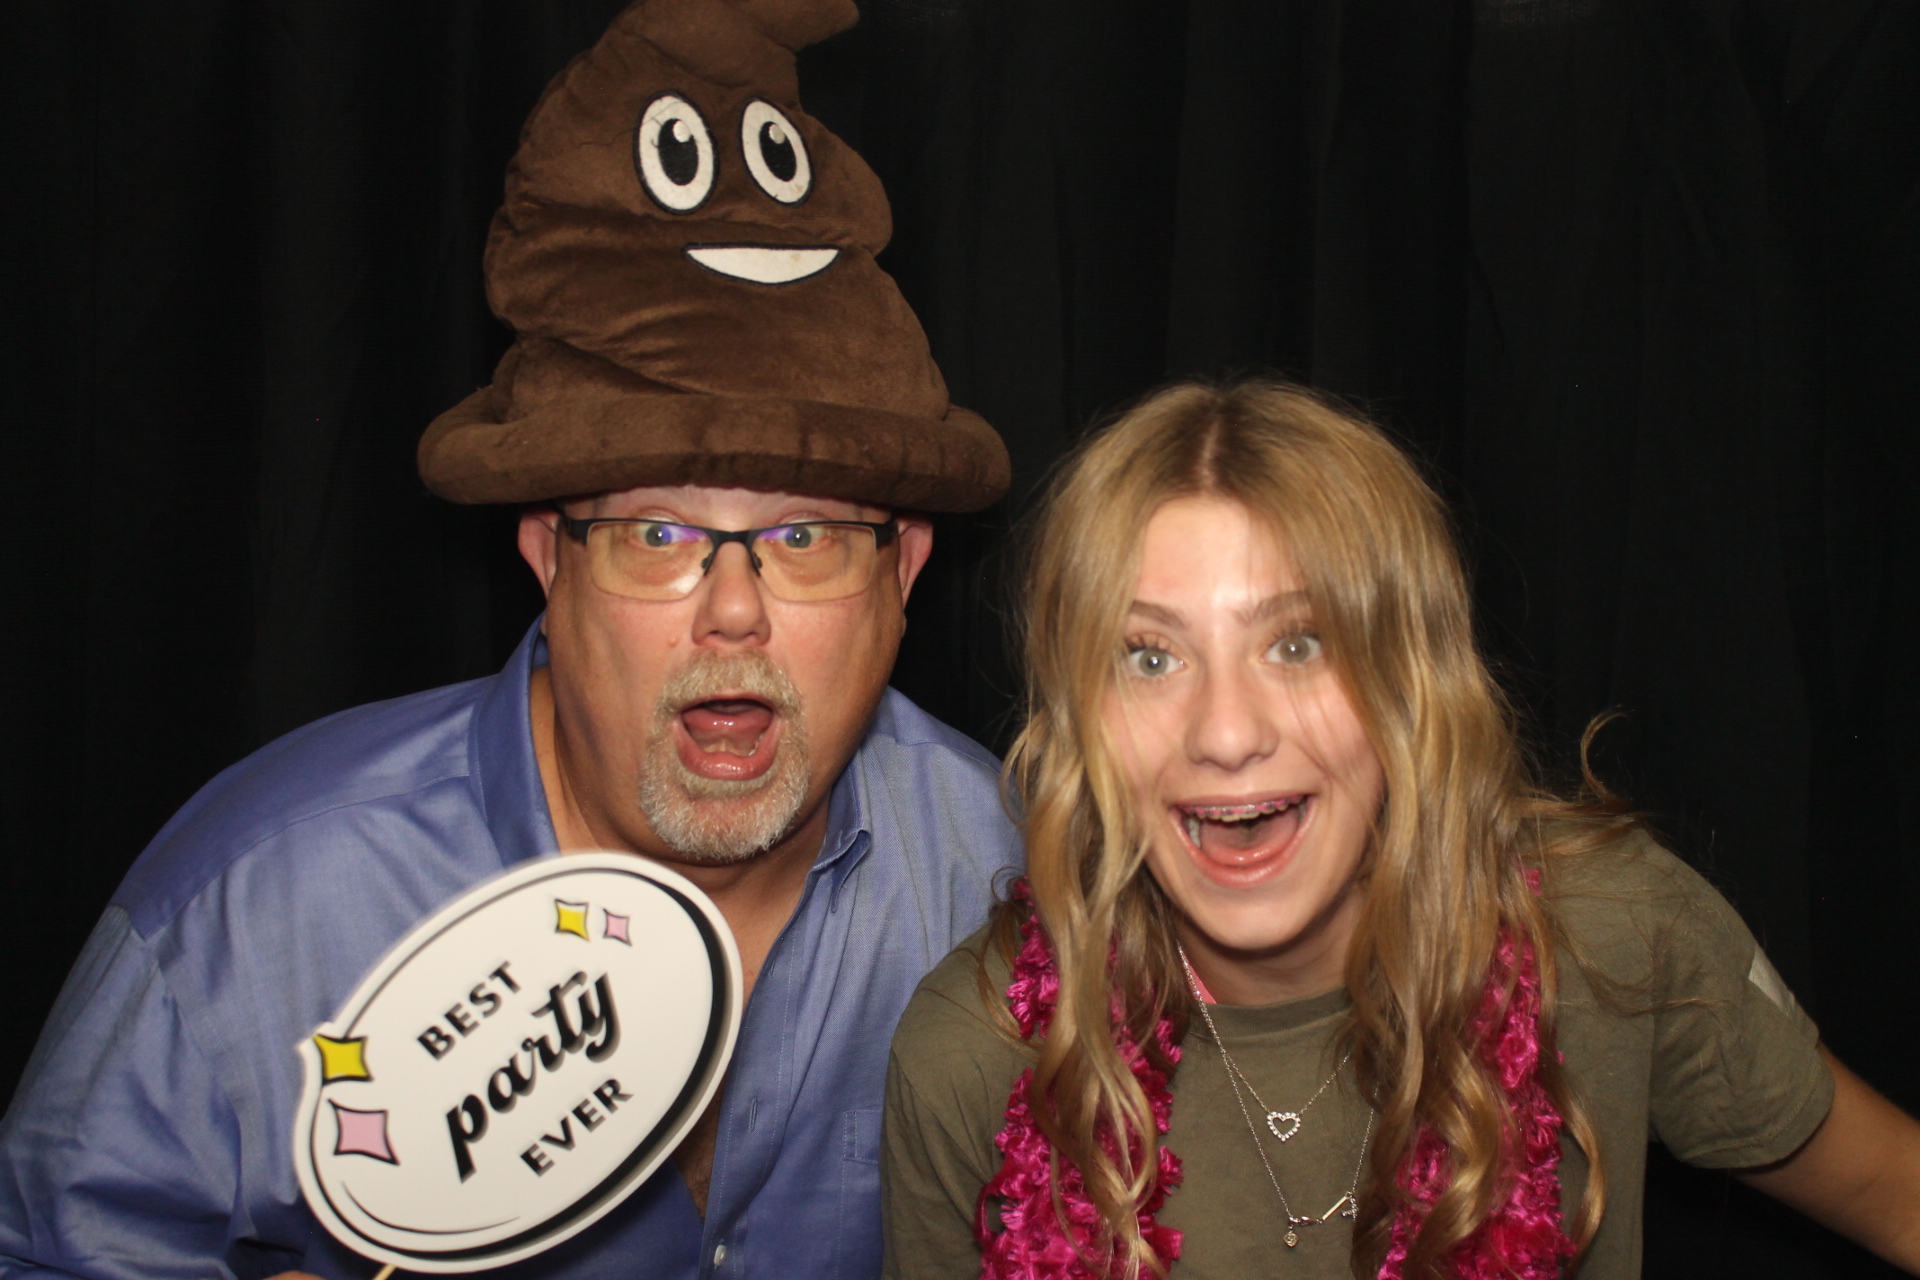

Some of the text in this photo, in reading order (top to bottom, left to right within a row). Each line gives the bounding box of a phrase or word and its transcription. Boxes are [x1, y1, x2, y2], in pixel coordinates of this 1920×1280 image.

[416, 960, 521, 1061] BEST
[445, 970, 621, 1184] party
[519, 1077, 633, 1177] EVER
